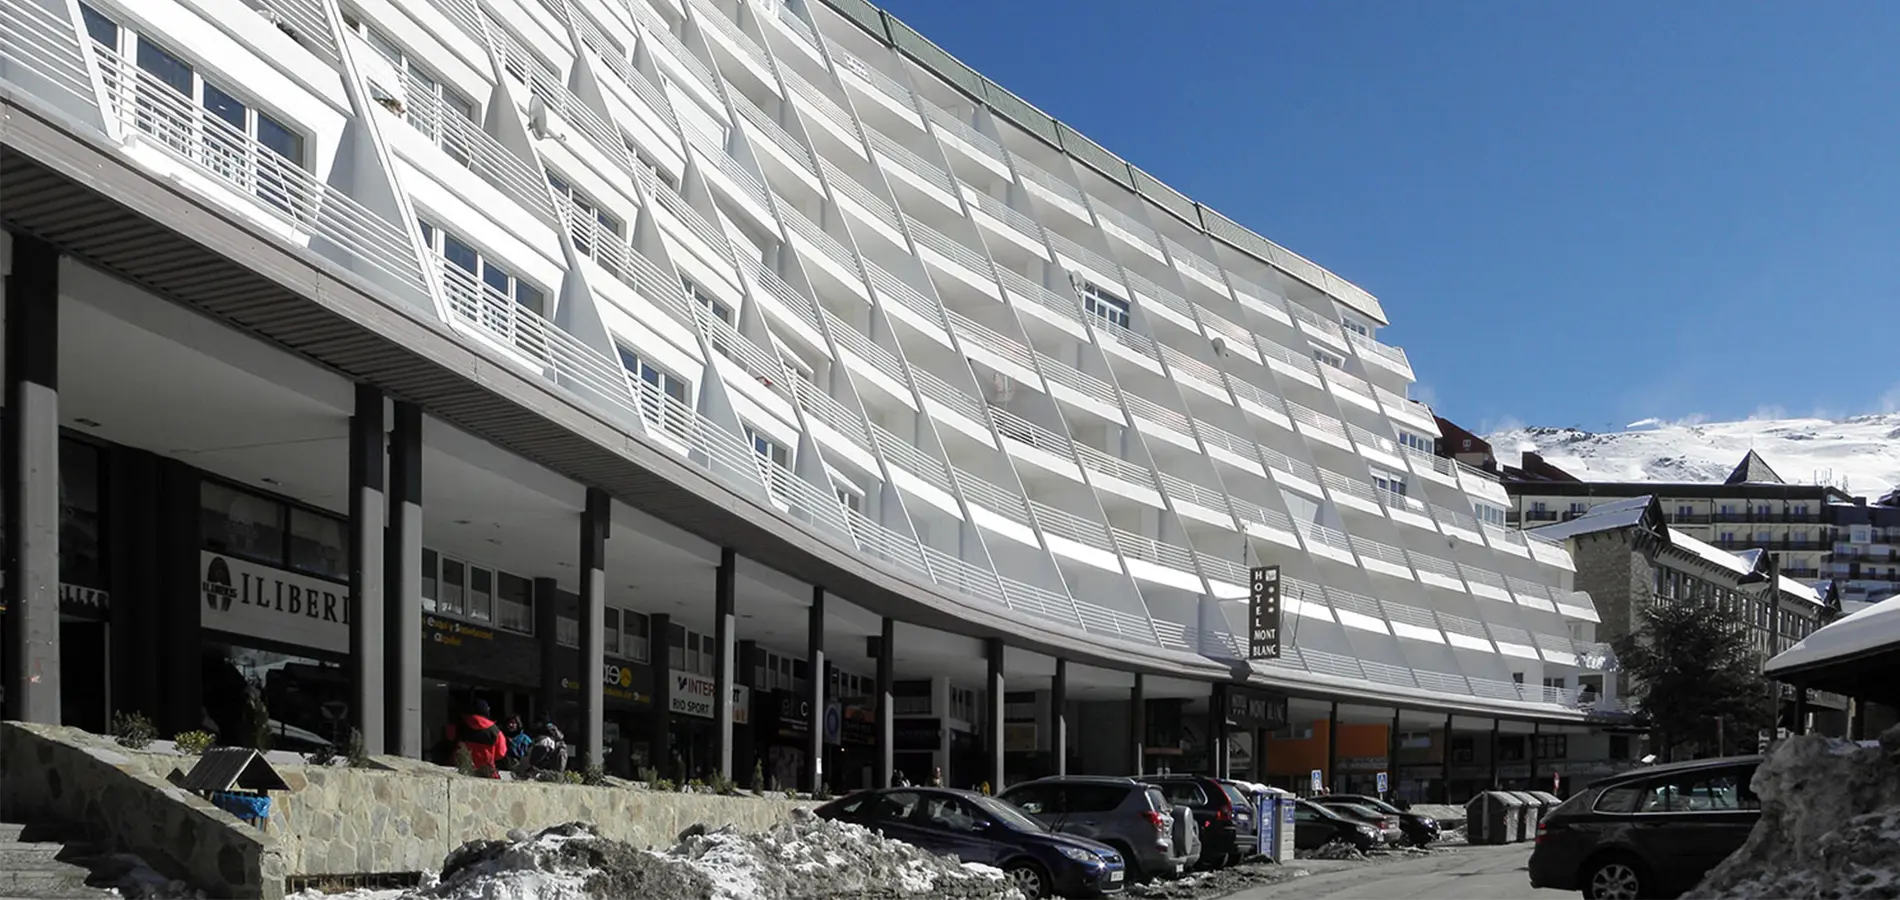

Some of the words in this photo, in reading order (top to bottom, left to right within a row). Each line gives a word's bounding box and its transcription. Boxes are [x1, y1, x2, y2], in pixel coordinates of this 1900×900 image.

[1254, 571, 1263, 627] HOTEL
[1254, 629, 1276, 640] MONT
[1253, 644, 1277, 656] BLANC
[687, 701, 710, 713] SPORT
